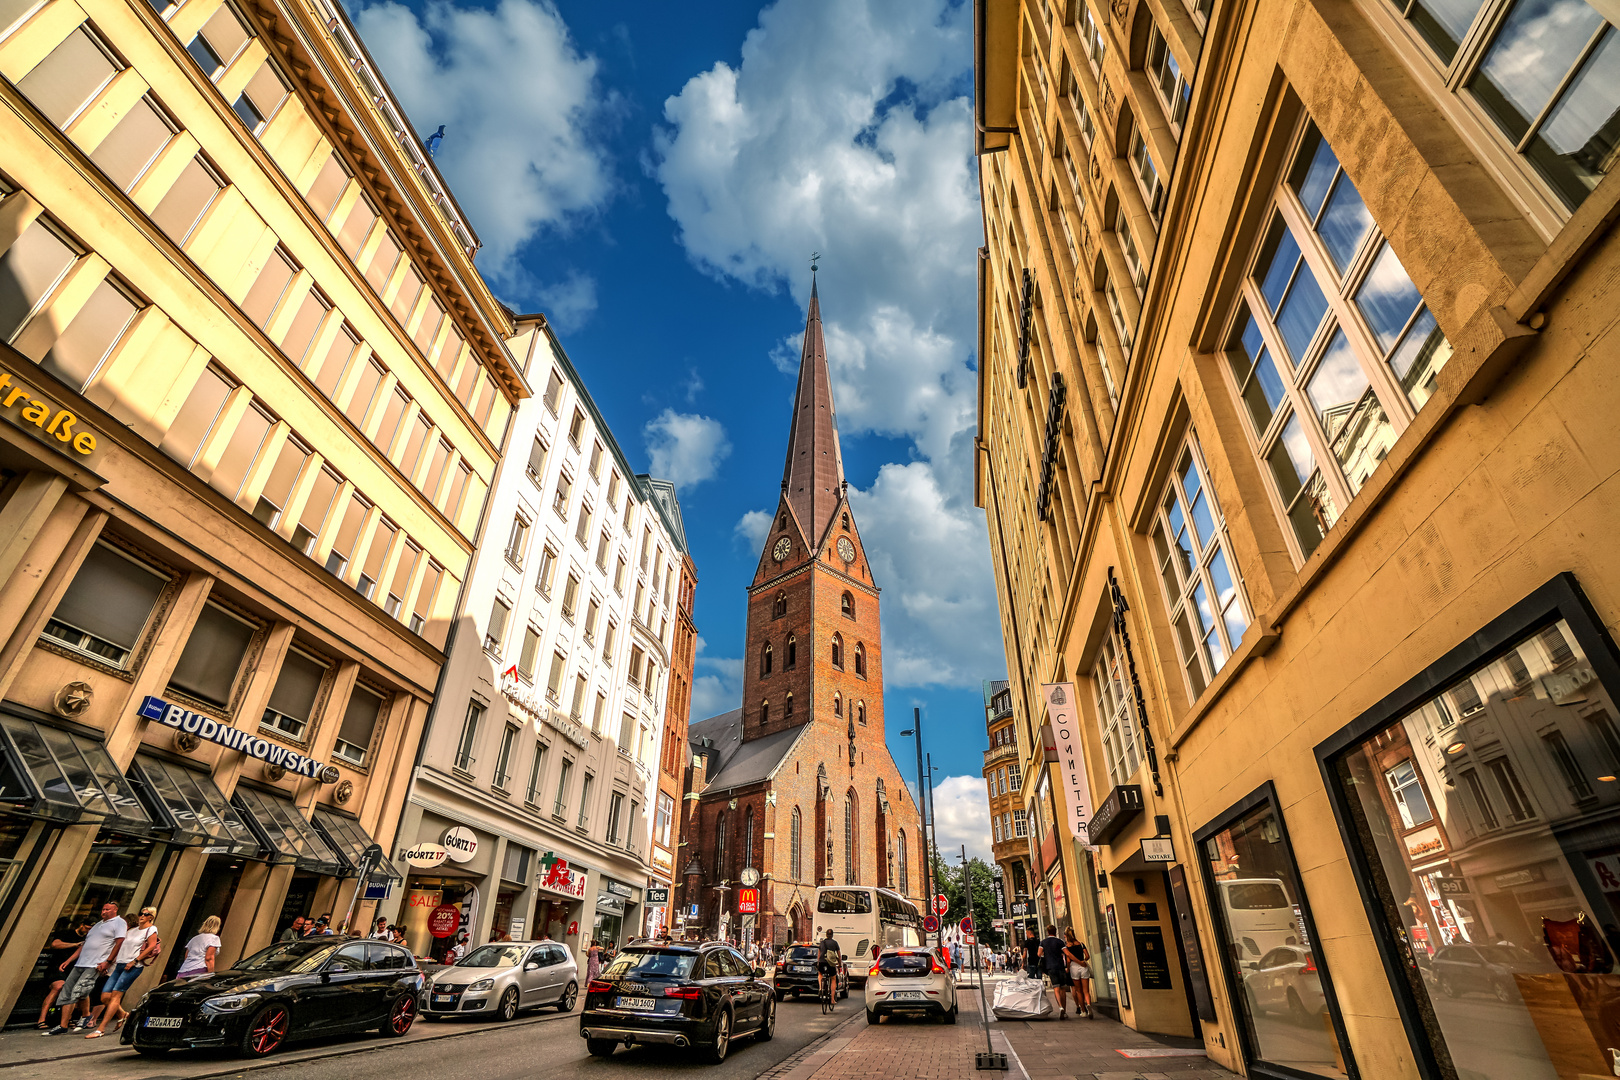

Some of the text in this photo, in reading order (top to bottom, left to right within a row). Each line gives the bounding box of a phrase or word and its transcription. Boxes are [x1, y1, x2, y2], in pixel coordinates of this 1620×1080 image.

[163, 704, 324, 778] BUDNIKOWSKY
[1122, 790, 1139, 804] 11
[469, 841, 477, 853] 17
[435, 851, 445, 860] 17
[1147, 853, 1171, 861] NOTARE
[649, 890, 666, 901] Tee
[409, 895, 440, 908] SALE
[996, 888, 1004, 915] prediger
[436, 912, 454, 920] 20%
[172, 1018, 181, 1027] 16
